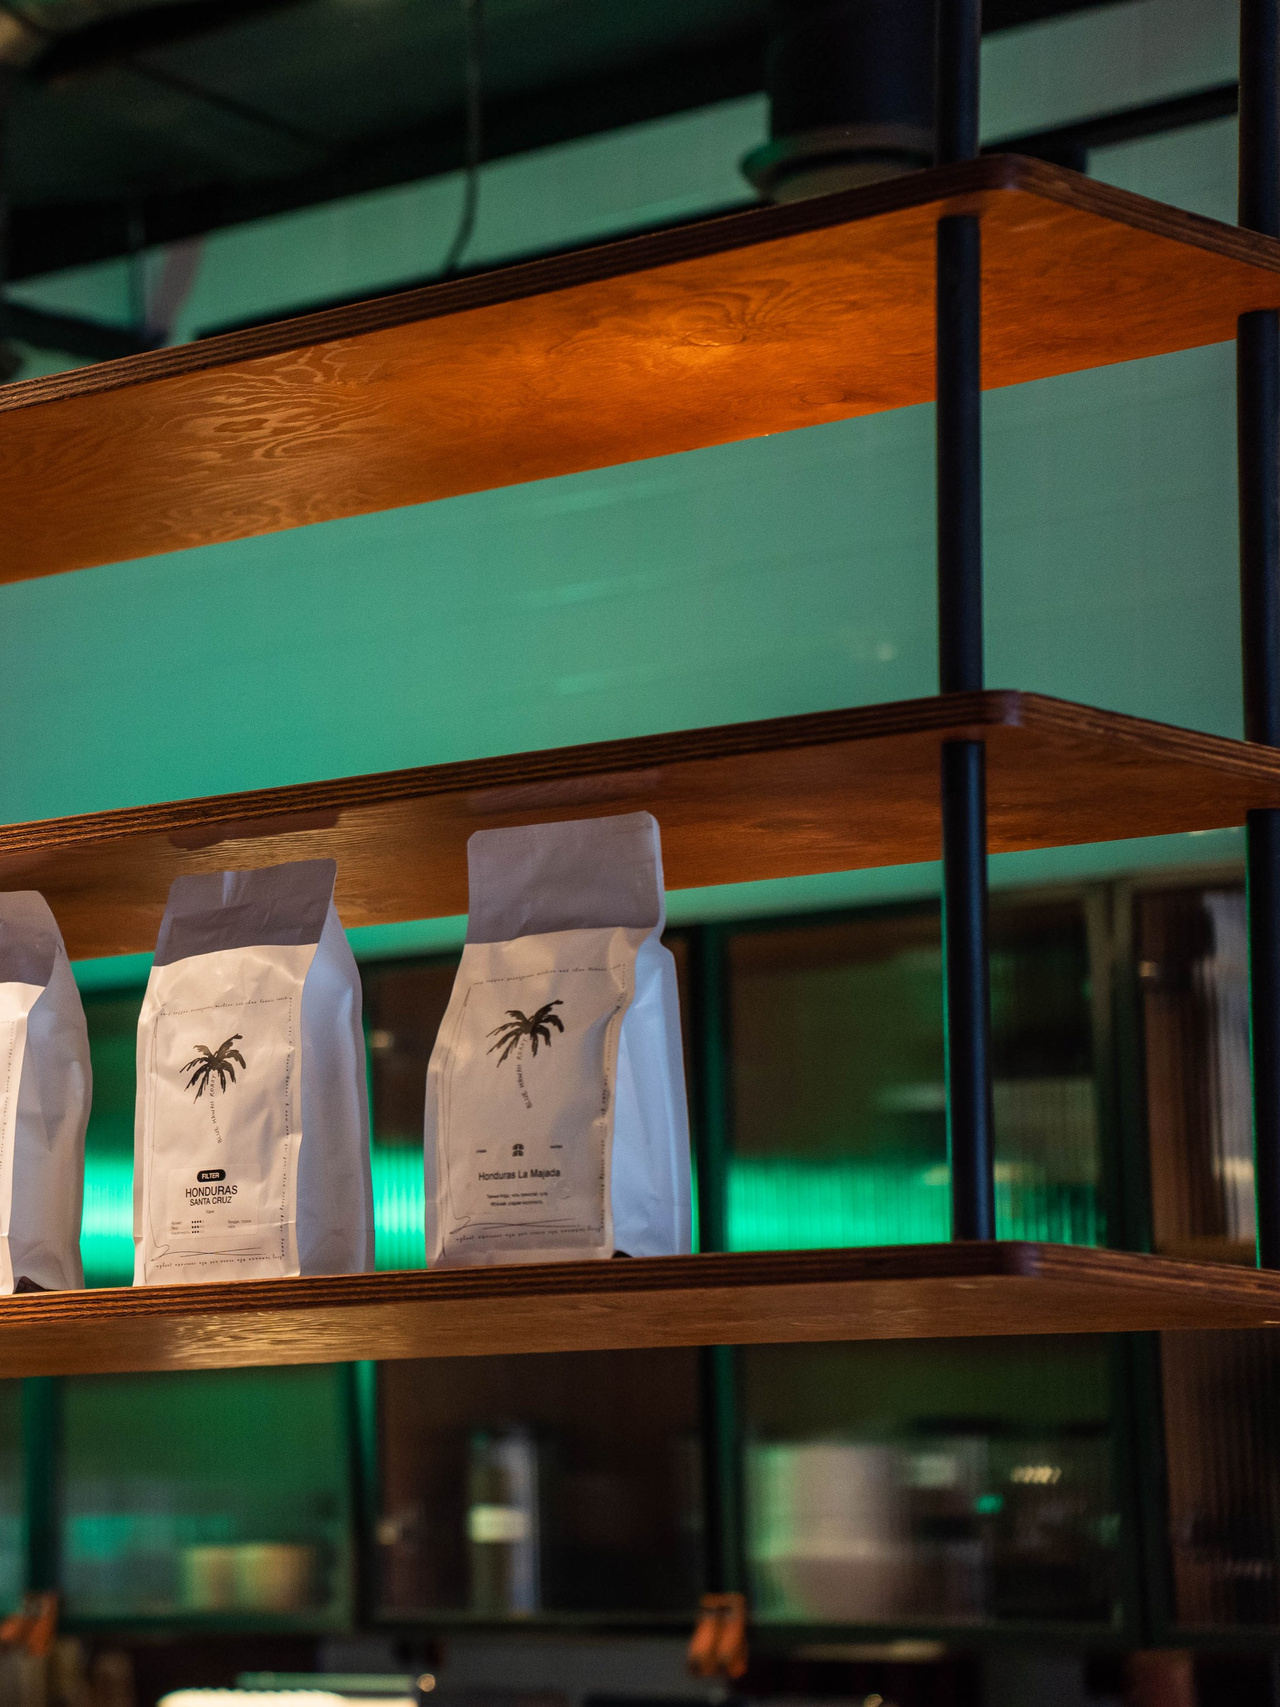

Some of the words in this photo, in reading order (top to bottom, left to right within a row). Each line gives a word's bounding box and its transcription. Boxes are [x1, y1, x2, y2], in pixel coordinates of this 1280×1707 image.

[478, 1171, 516, 1181] Honduras
[517, 1170, 528, 1178] La
[530, 1168, 561, 1180] Majada
[185, 1185, 238, 1198] HONDURAS
[189, 1197, 211, 1207] SANTA
[212, 1196, 232, 1205] CRUZ
